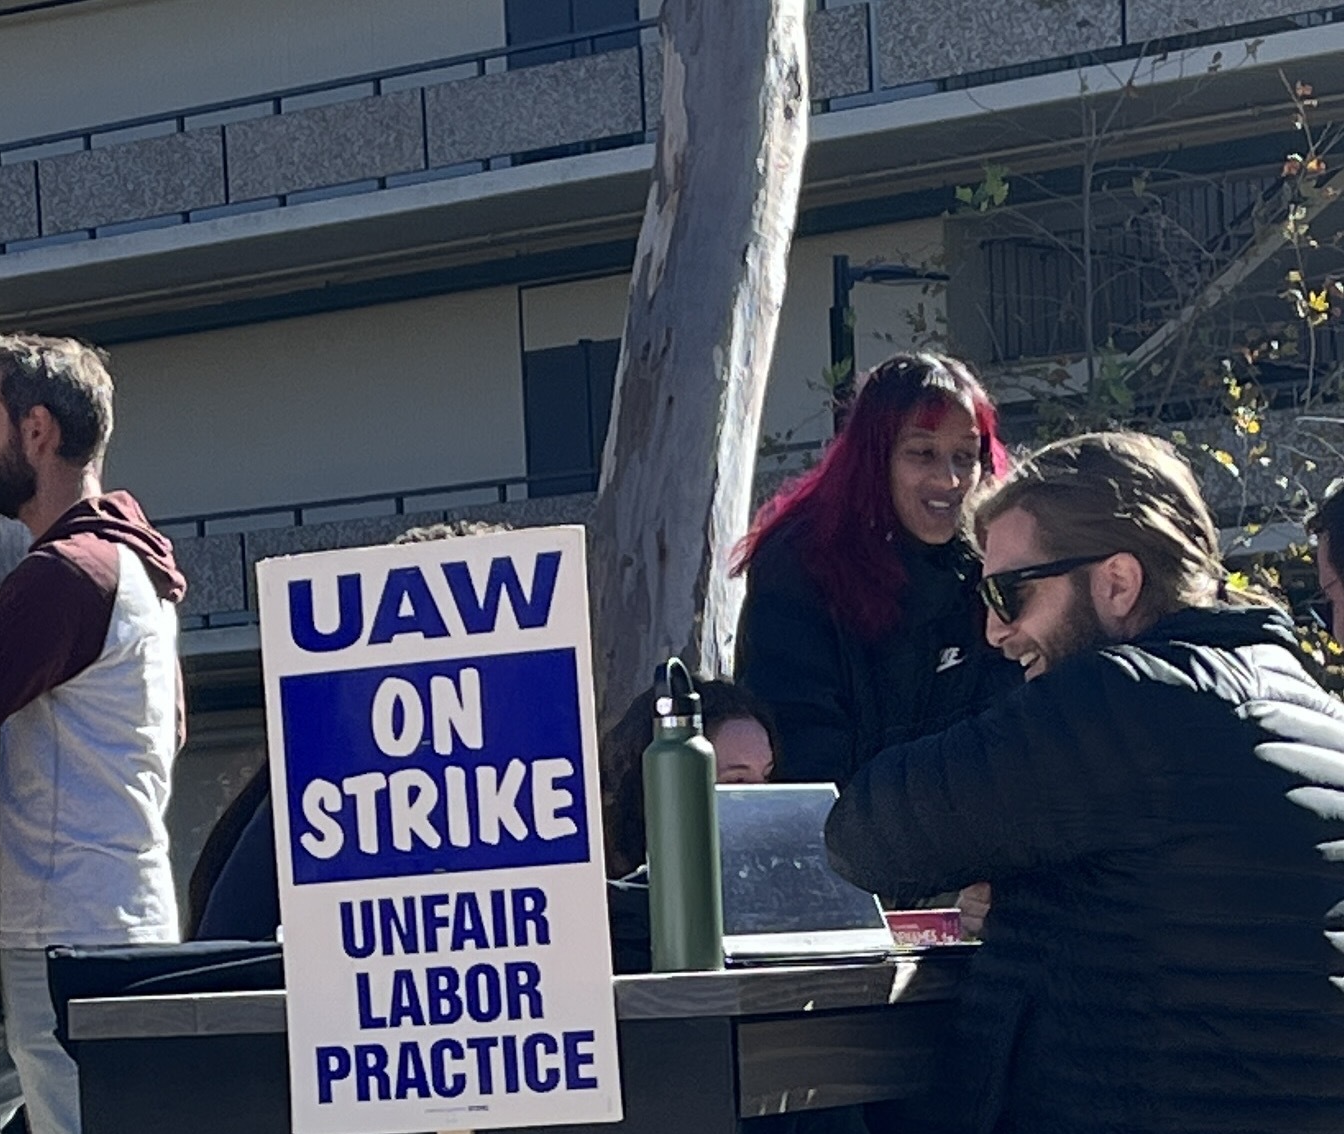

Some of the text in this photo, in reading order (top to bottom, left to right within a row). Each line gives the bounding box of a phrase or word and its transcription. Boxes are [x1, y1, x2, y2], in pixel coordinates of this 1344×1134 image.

[287, 550, 563, 654] UAW
[372, 667, 484, 757] ON
[300, 757, 578, 860] STRIKE
[339, 886, 552, 959] UNFAIR
[355, 960, 545, 1031] LABOR
[315, 1029, 599, 1105] PRACTICE
